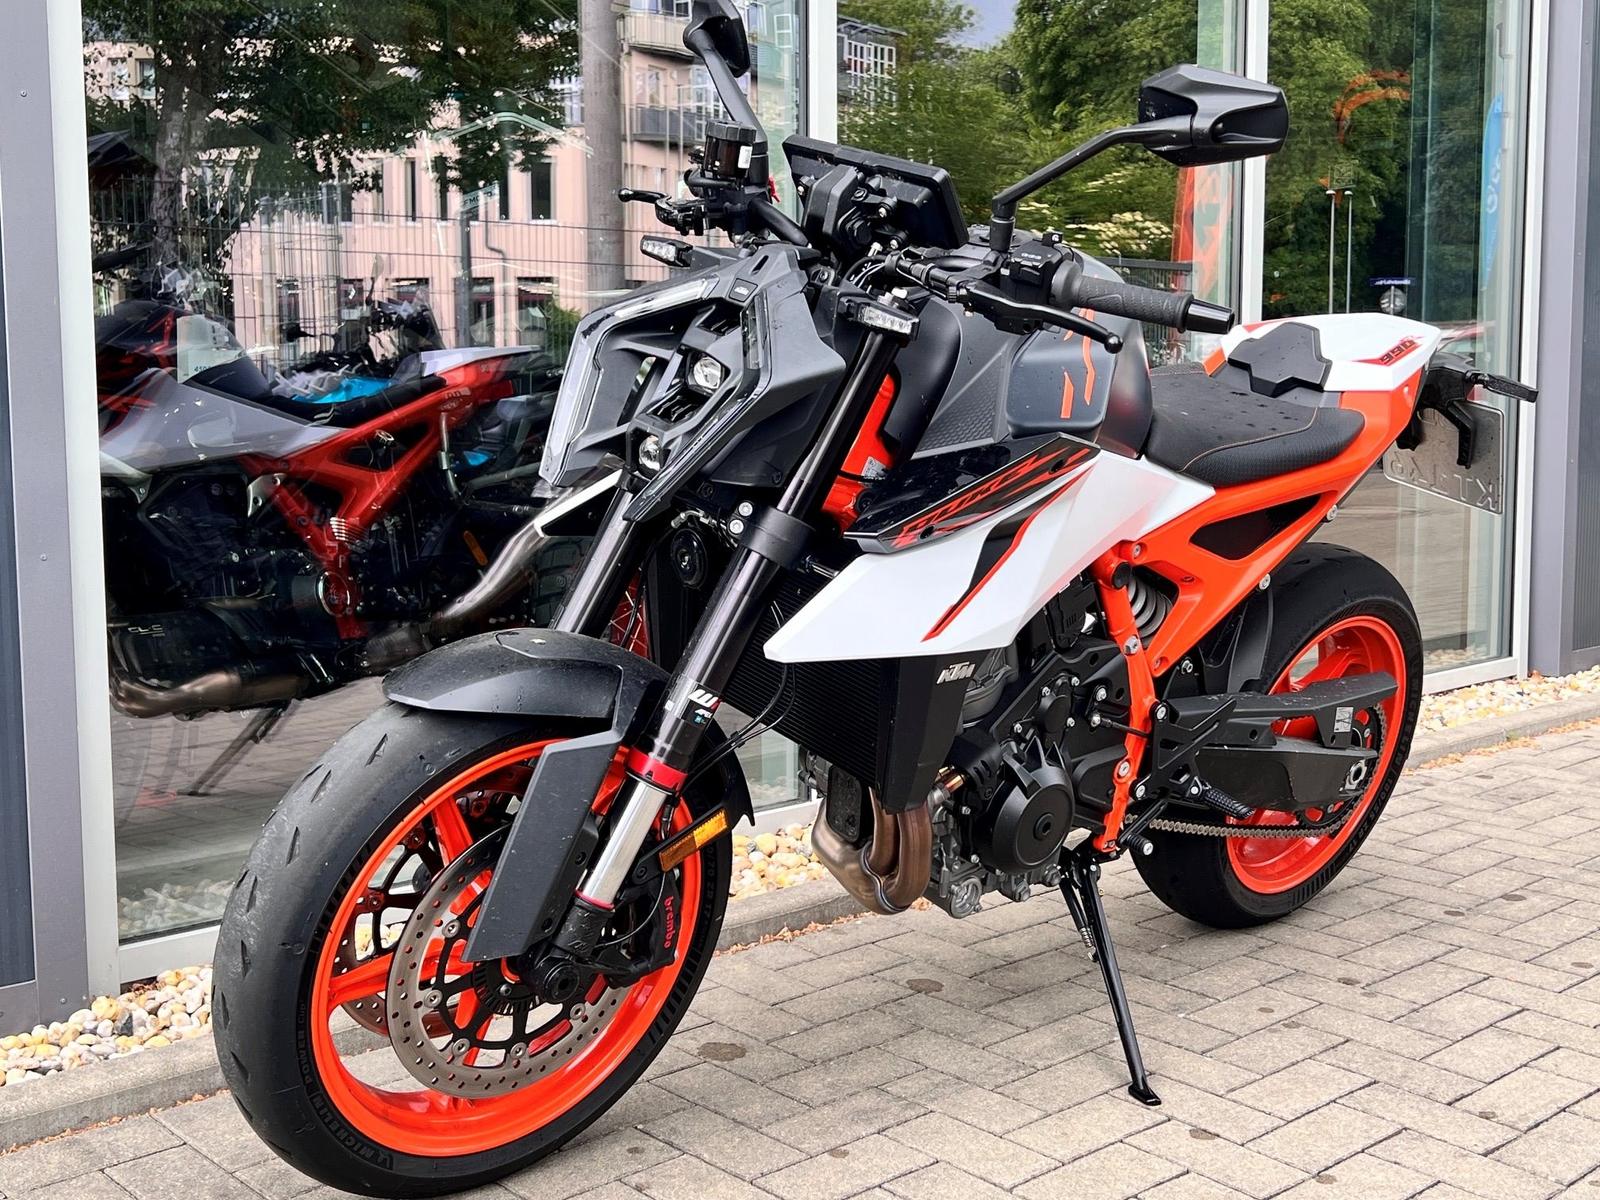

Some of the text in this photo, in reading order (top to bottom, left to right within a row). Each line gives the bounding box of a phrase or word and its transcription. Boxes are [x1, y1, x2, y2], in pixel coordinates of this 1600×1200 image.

[901, 454, 1038, 538] DUKE
[936, 661, 976, 685] KTM
[663, 895, 676, 949] brembo
[297, 1029, 312, 1085] POWER
[312, 1096, 375, 1160] MICHELIN
